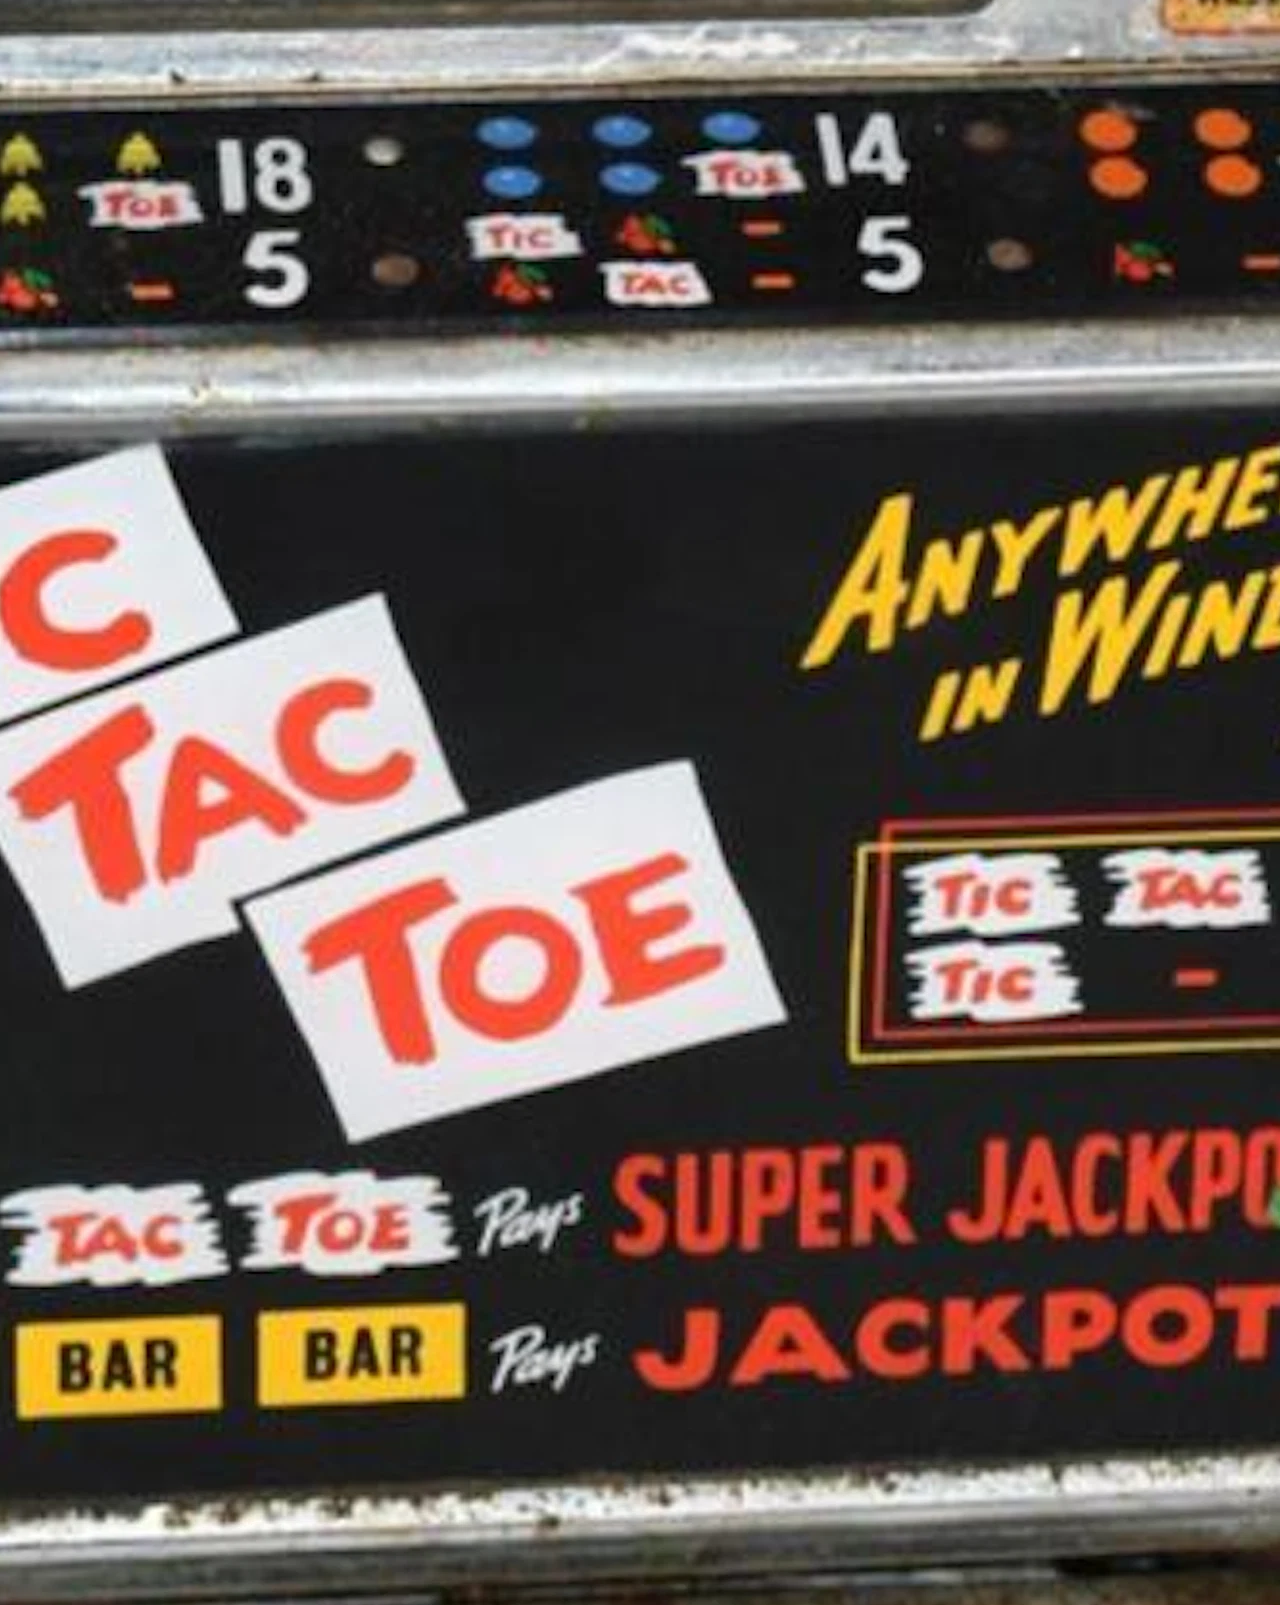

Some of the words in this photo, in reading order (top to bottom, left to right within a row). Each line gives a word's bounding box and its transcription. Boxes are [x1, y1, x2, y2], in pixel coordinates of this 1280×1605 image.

[218, 137, 313, 214] 18
[816, 111, 911, 187] 14
[243, 229, 310, 308] 5
[619, 271, 689, 296] TAC
[856, 215, 923, 292] 5
[919, 658, 1022, 741] IN
[10, 678, 417, 905] TAC
[935, 872, 1034, 919] TIC
[1136, 866, 1243, 913] TAC
[302, 852, 724, 1067] TOE
[935, 959, 1036, 1003] TIC
[48, 1210, 185, 1267] TAC
[273, 1193, 413, 1253] TOE
[473, 1188, 584, 1256] Pays
[612, 1141, 915, 1259] SUPER
[58, 1336, 178, 1393] BAR
[304, 1326, 424, 1383] BAR
[489, 1325, 601, 1393] Pays
